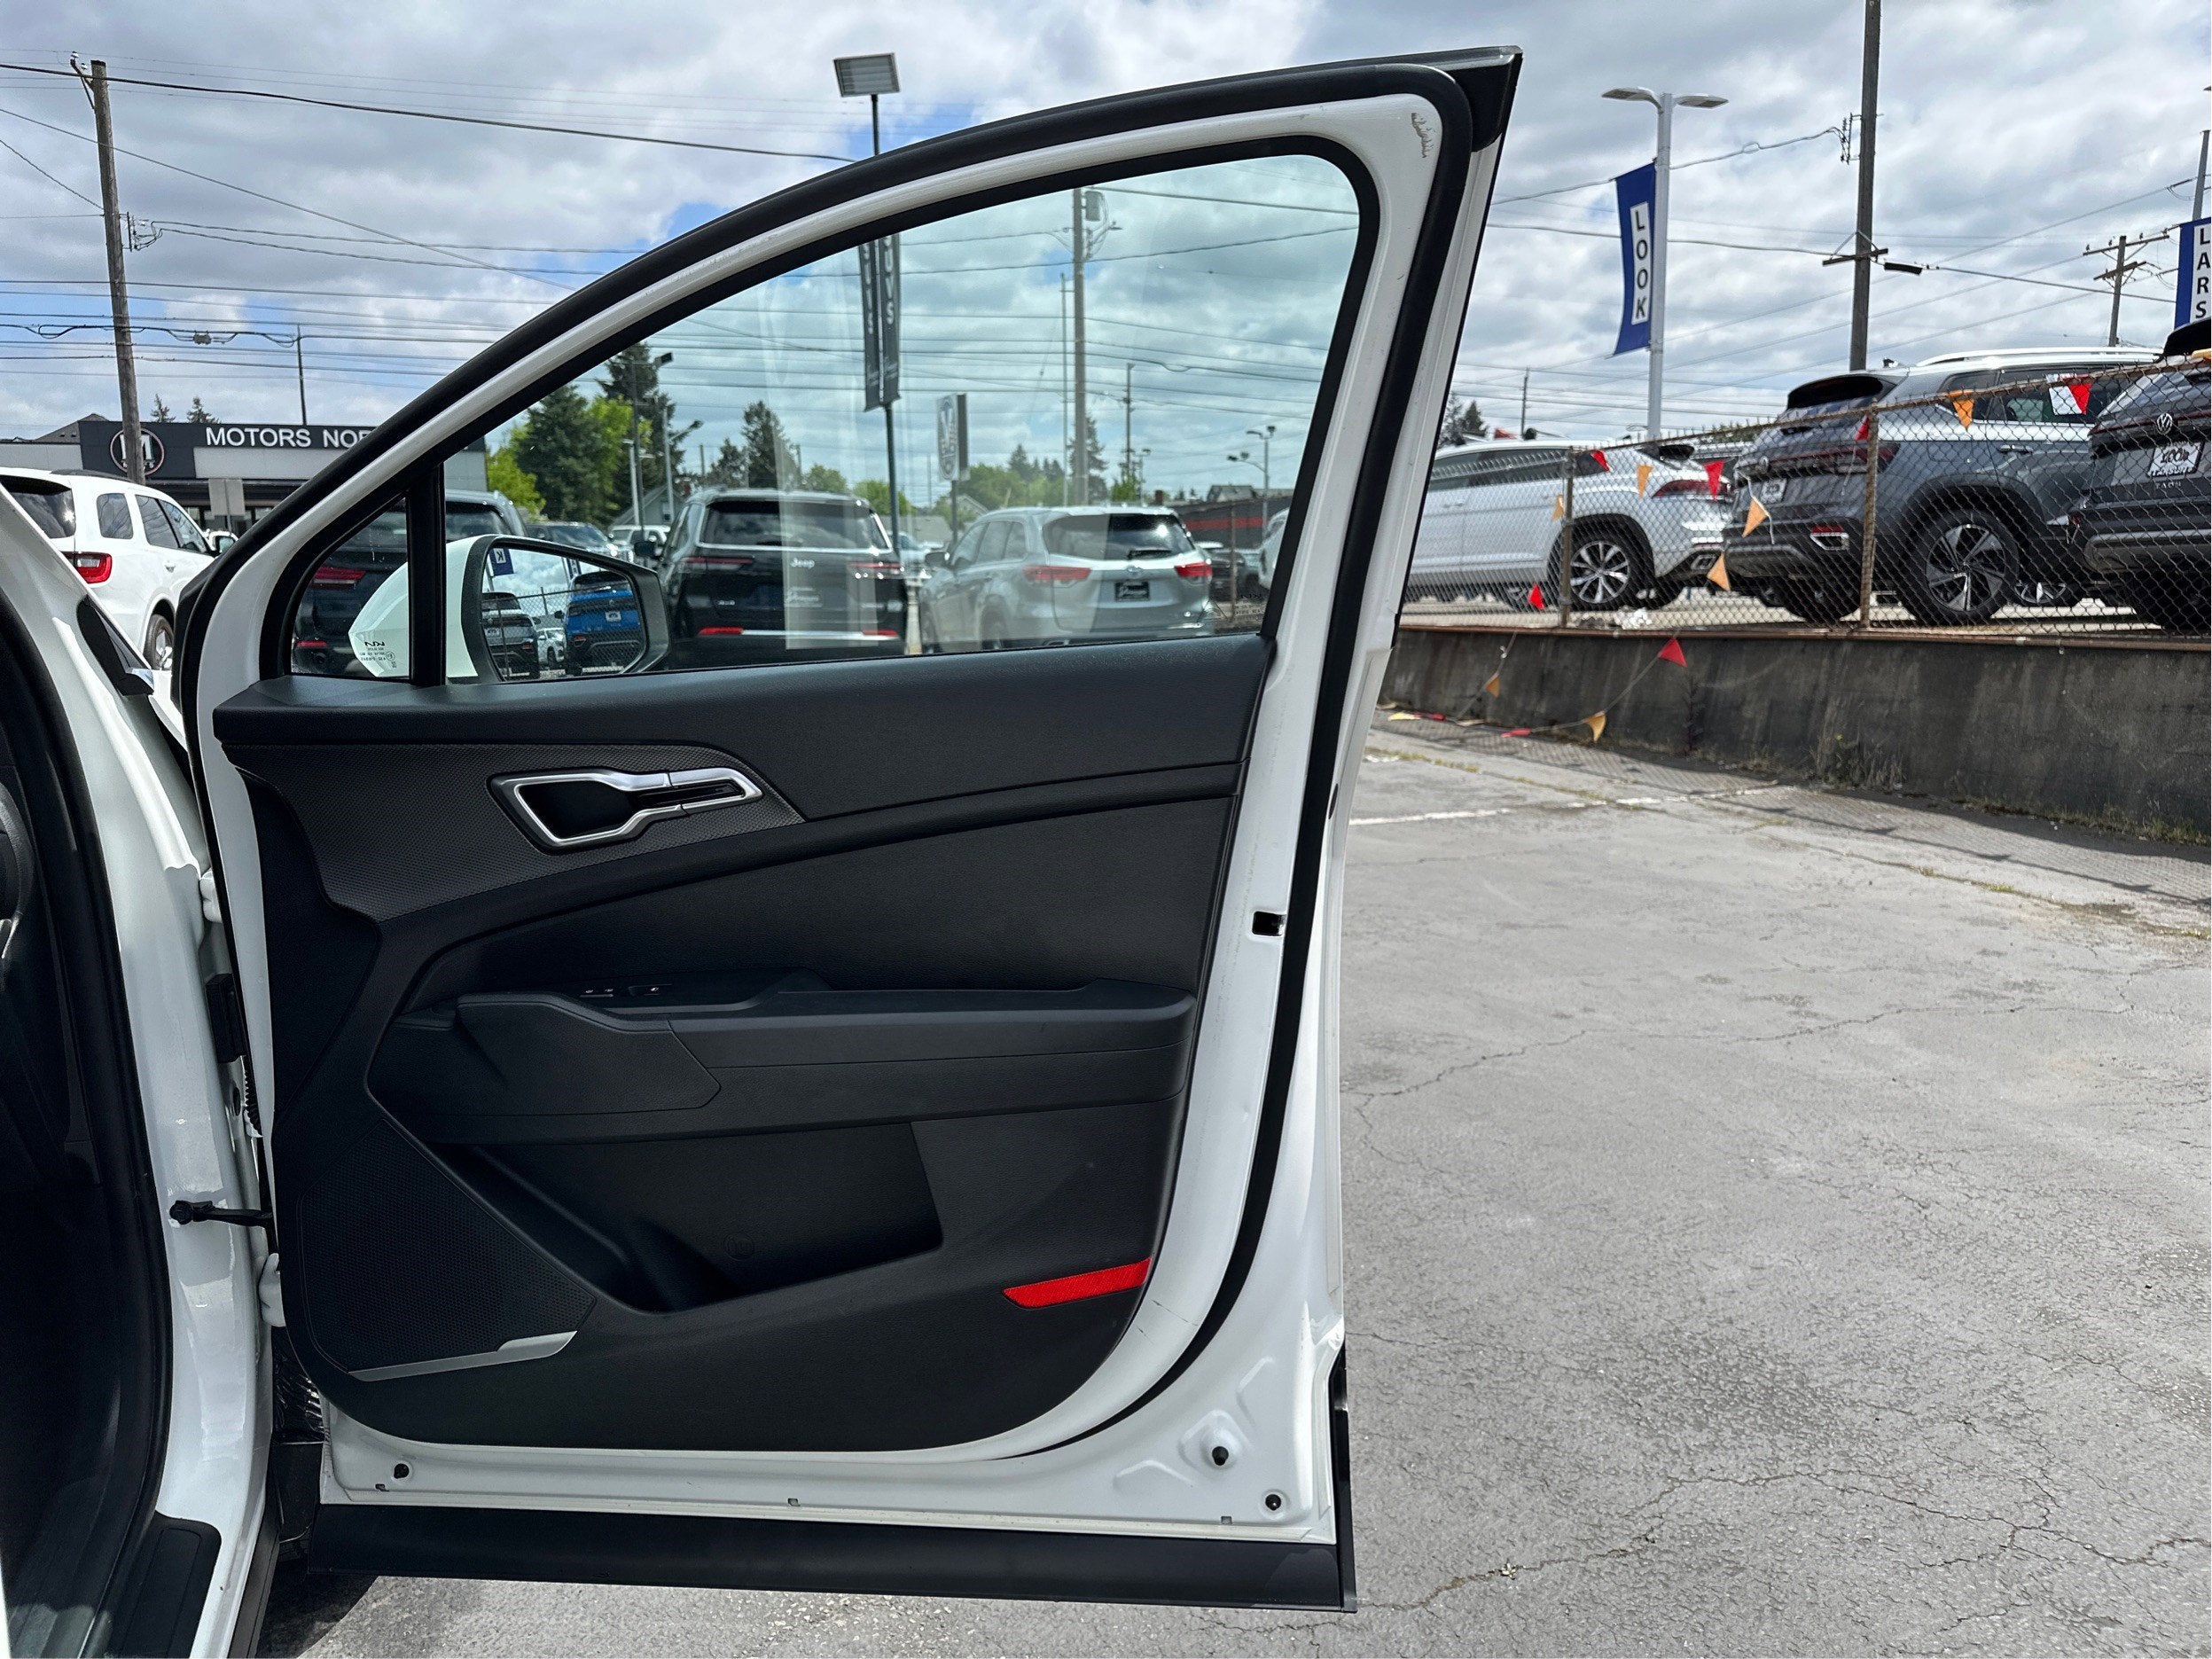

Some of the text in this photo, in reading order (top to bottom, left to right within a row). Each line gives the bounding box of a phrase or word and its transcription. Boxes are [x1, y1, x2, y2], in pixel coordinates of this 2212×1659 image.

[1635, 210, 1648, 319] LOOK
[206, 426, 311, 448] MOTORS
[790, 558, 815, 569] Jeep
